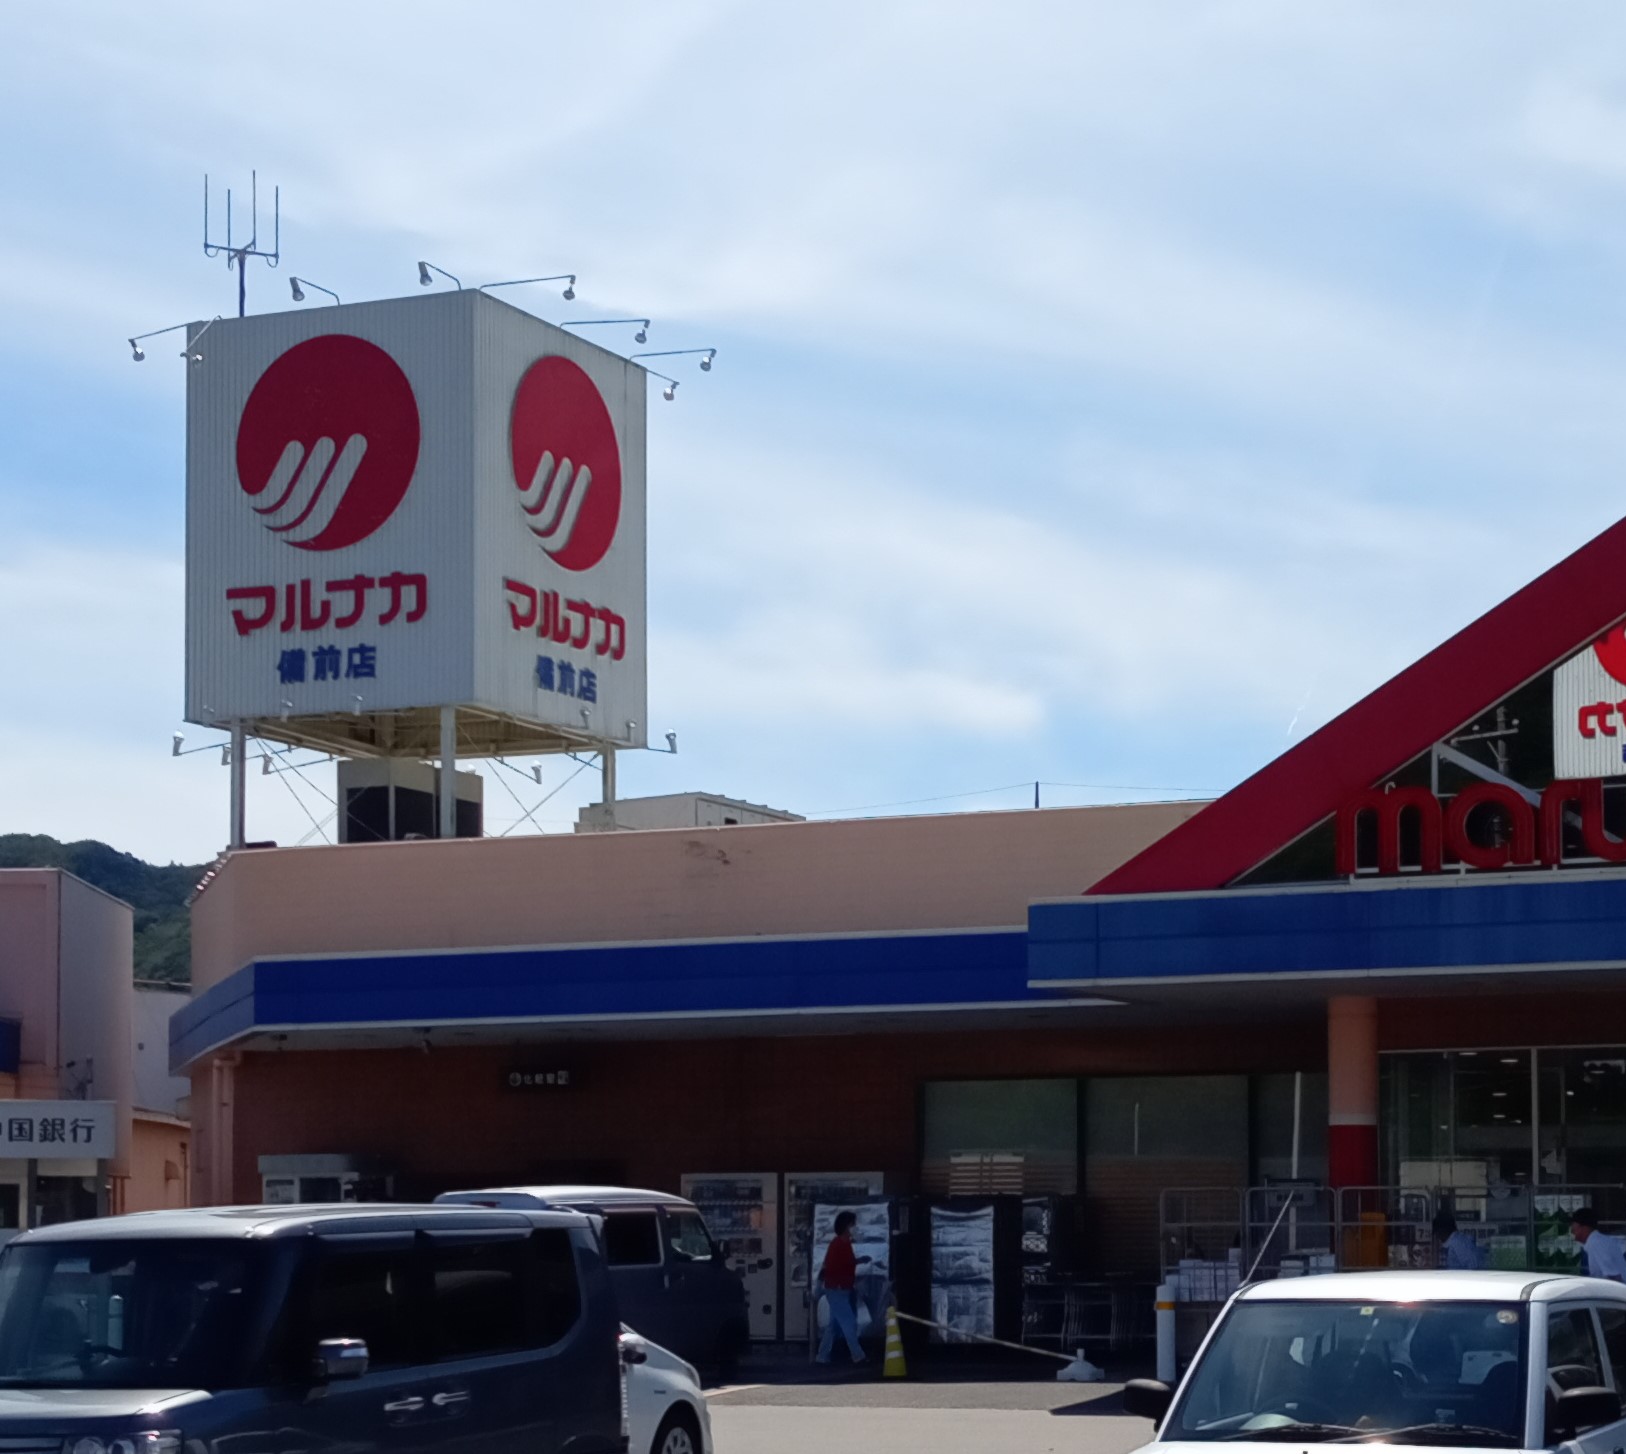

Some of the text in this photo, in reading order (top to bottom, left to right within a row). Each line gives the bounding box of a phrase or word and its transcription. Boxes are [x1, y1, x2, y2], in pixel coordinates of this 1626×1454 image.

[226, 571, 428, 636] マルナカ
[503, 577, 626, 660] マルナカ
[277, 643, 377, 684] 備前店
[534, 654, 598, 704] 備前店
[0, 1118, 96, 1143] 国銀行
